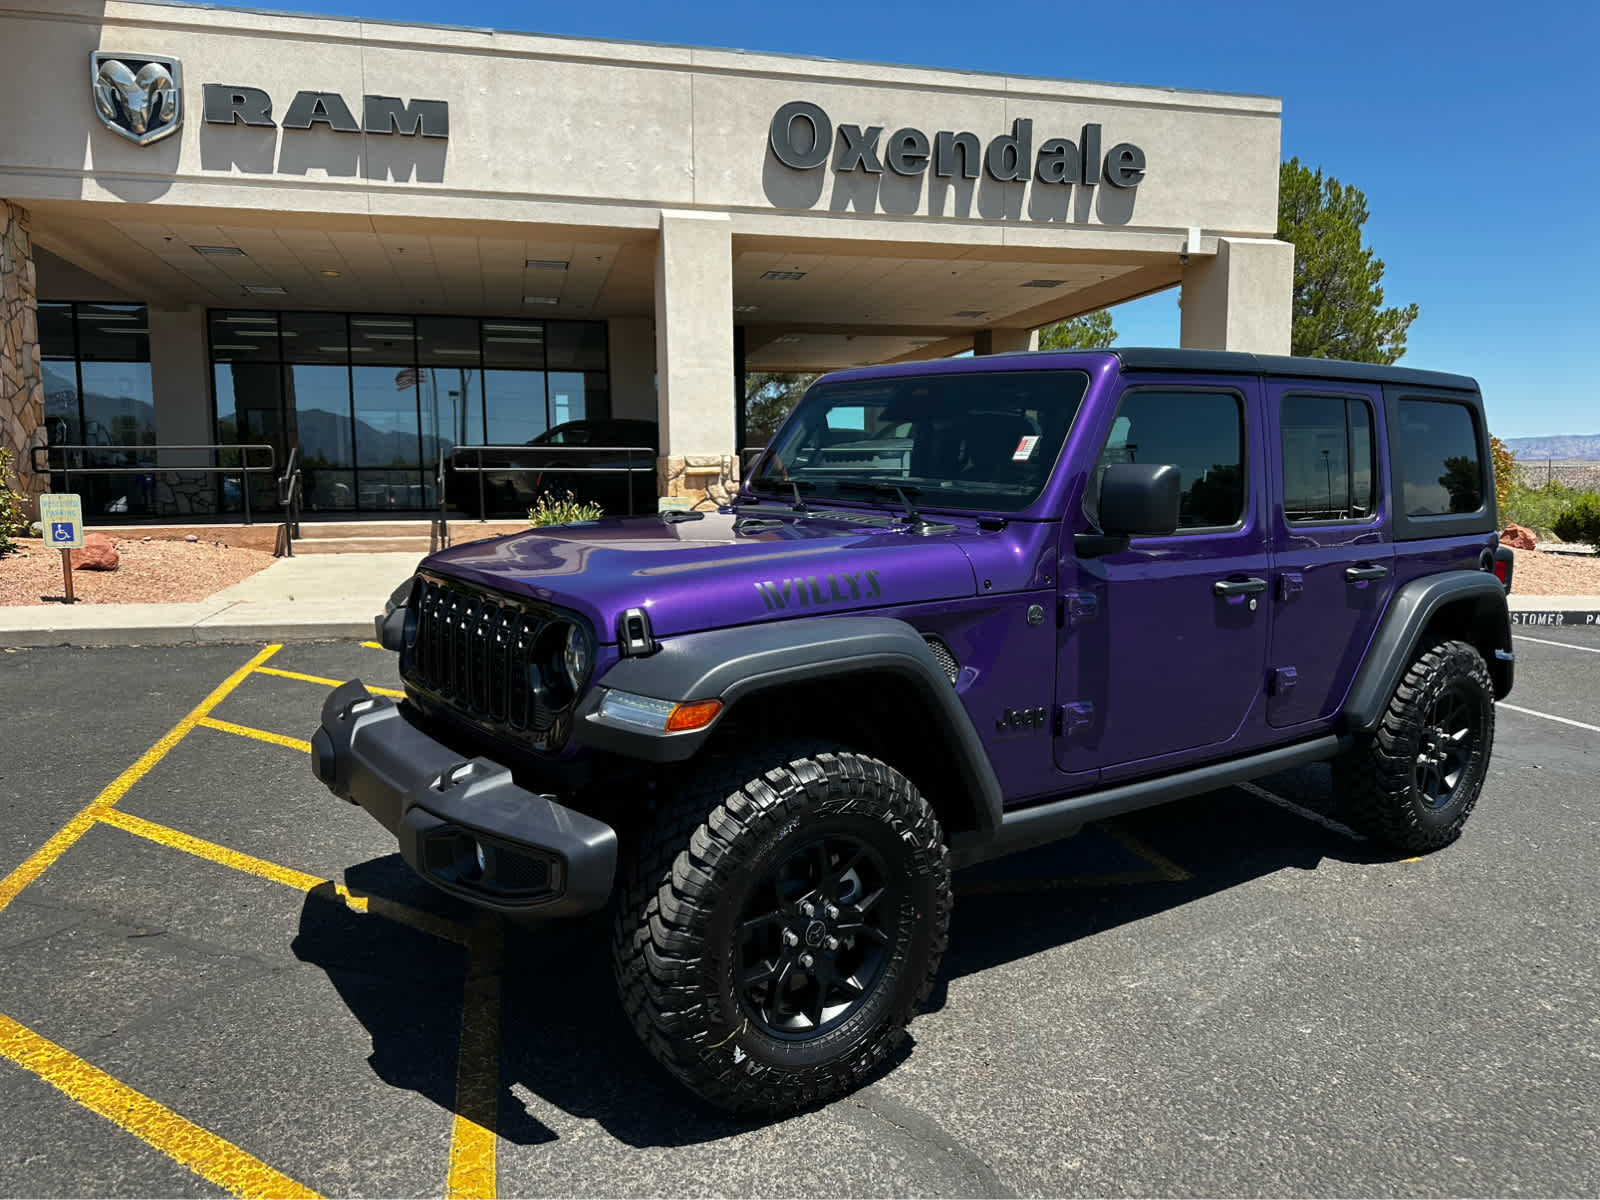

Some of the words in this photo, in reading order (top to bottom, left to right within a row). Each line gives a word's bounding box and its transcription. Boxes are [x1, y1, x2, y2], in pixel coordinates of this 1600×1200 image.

[201, 83, 449, 138] RAM
[769, 100, 1146, 188] Oxendale
[753, 568, 881, 610] WILLYS
[996, 706, 1046, 736] Jeep
